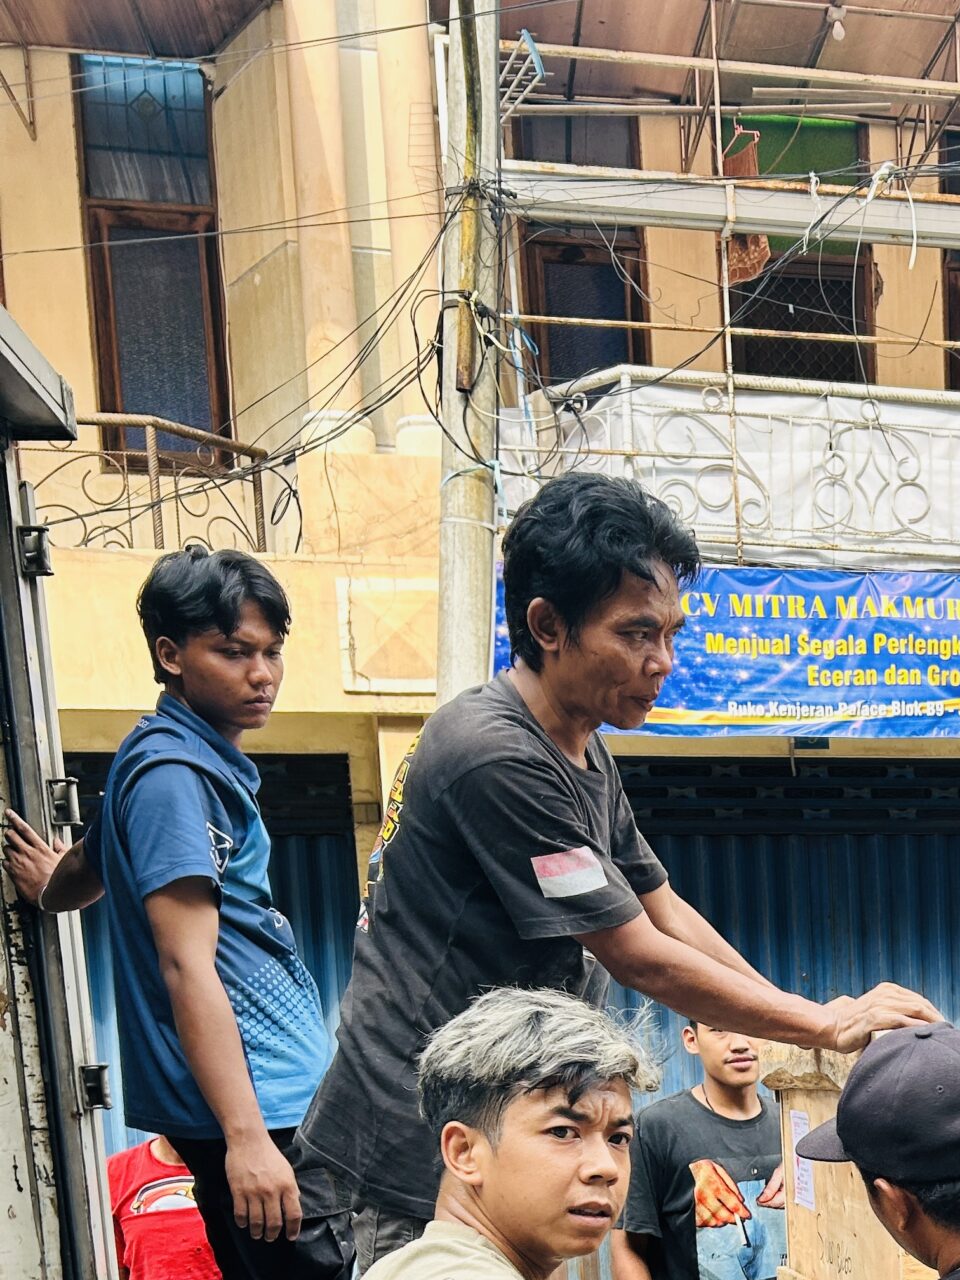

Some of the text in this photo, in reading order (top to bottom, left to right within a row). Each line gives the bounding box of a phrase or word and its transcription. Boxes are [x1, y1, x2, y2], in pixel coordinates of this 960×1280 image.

[681, 592, 720, 618] CV
[728, 593, 829, 620] MITRA
[705, 632, 790, 659] Menjual
[797, 634, 867, 660] Segala
[807, 665, 877, 687] Eceran
[884, 664, 921, 686] dan
[728, 701, 765, 716] Ruko
[769, 701, 834, 720] Kenjeran
[838, 701, 887, 717] Palace
[892, 700, 923, 717] Blok
[926, 702, 945, 717] B9
